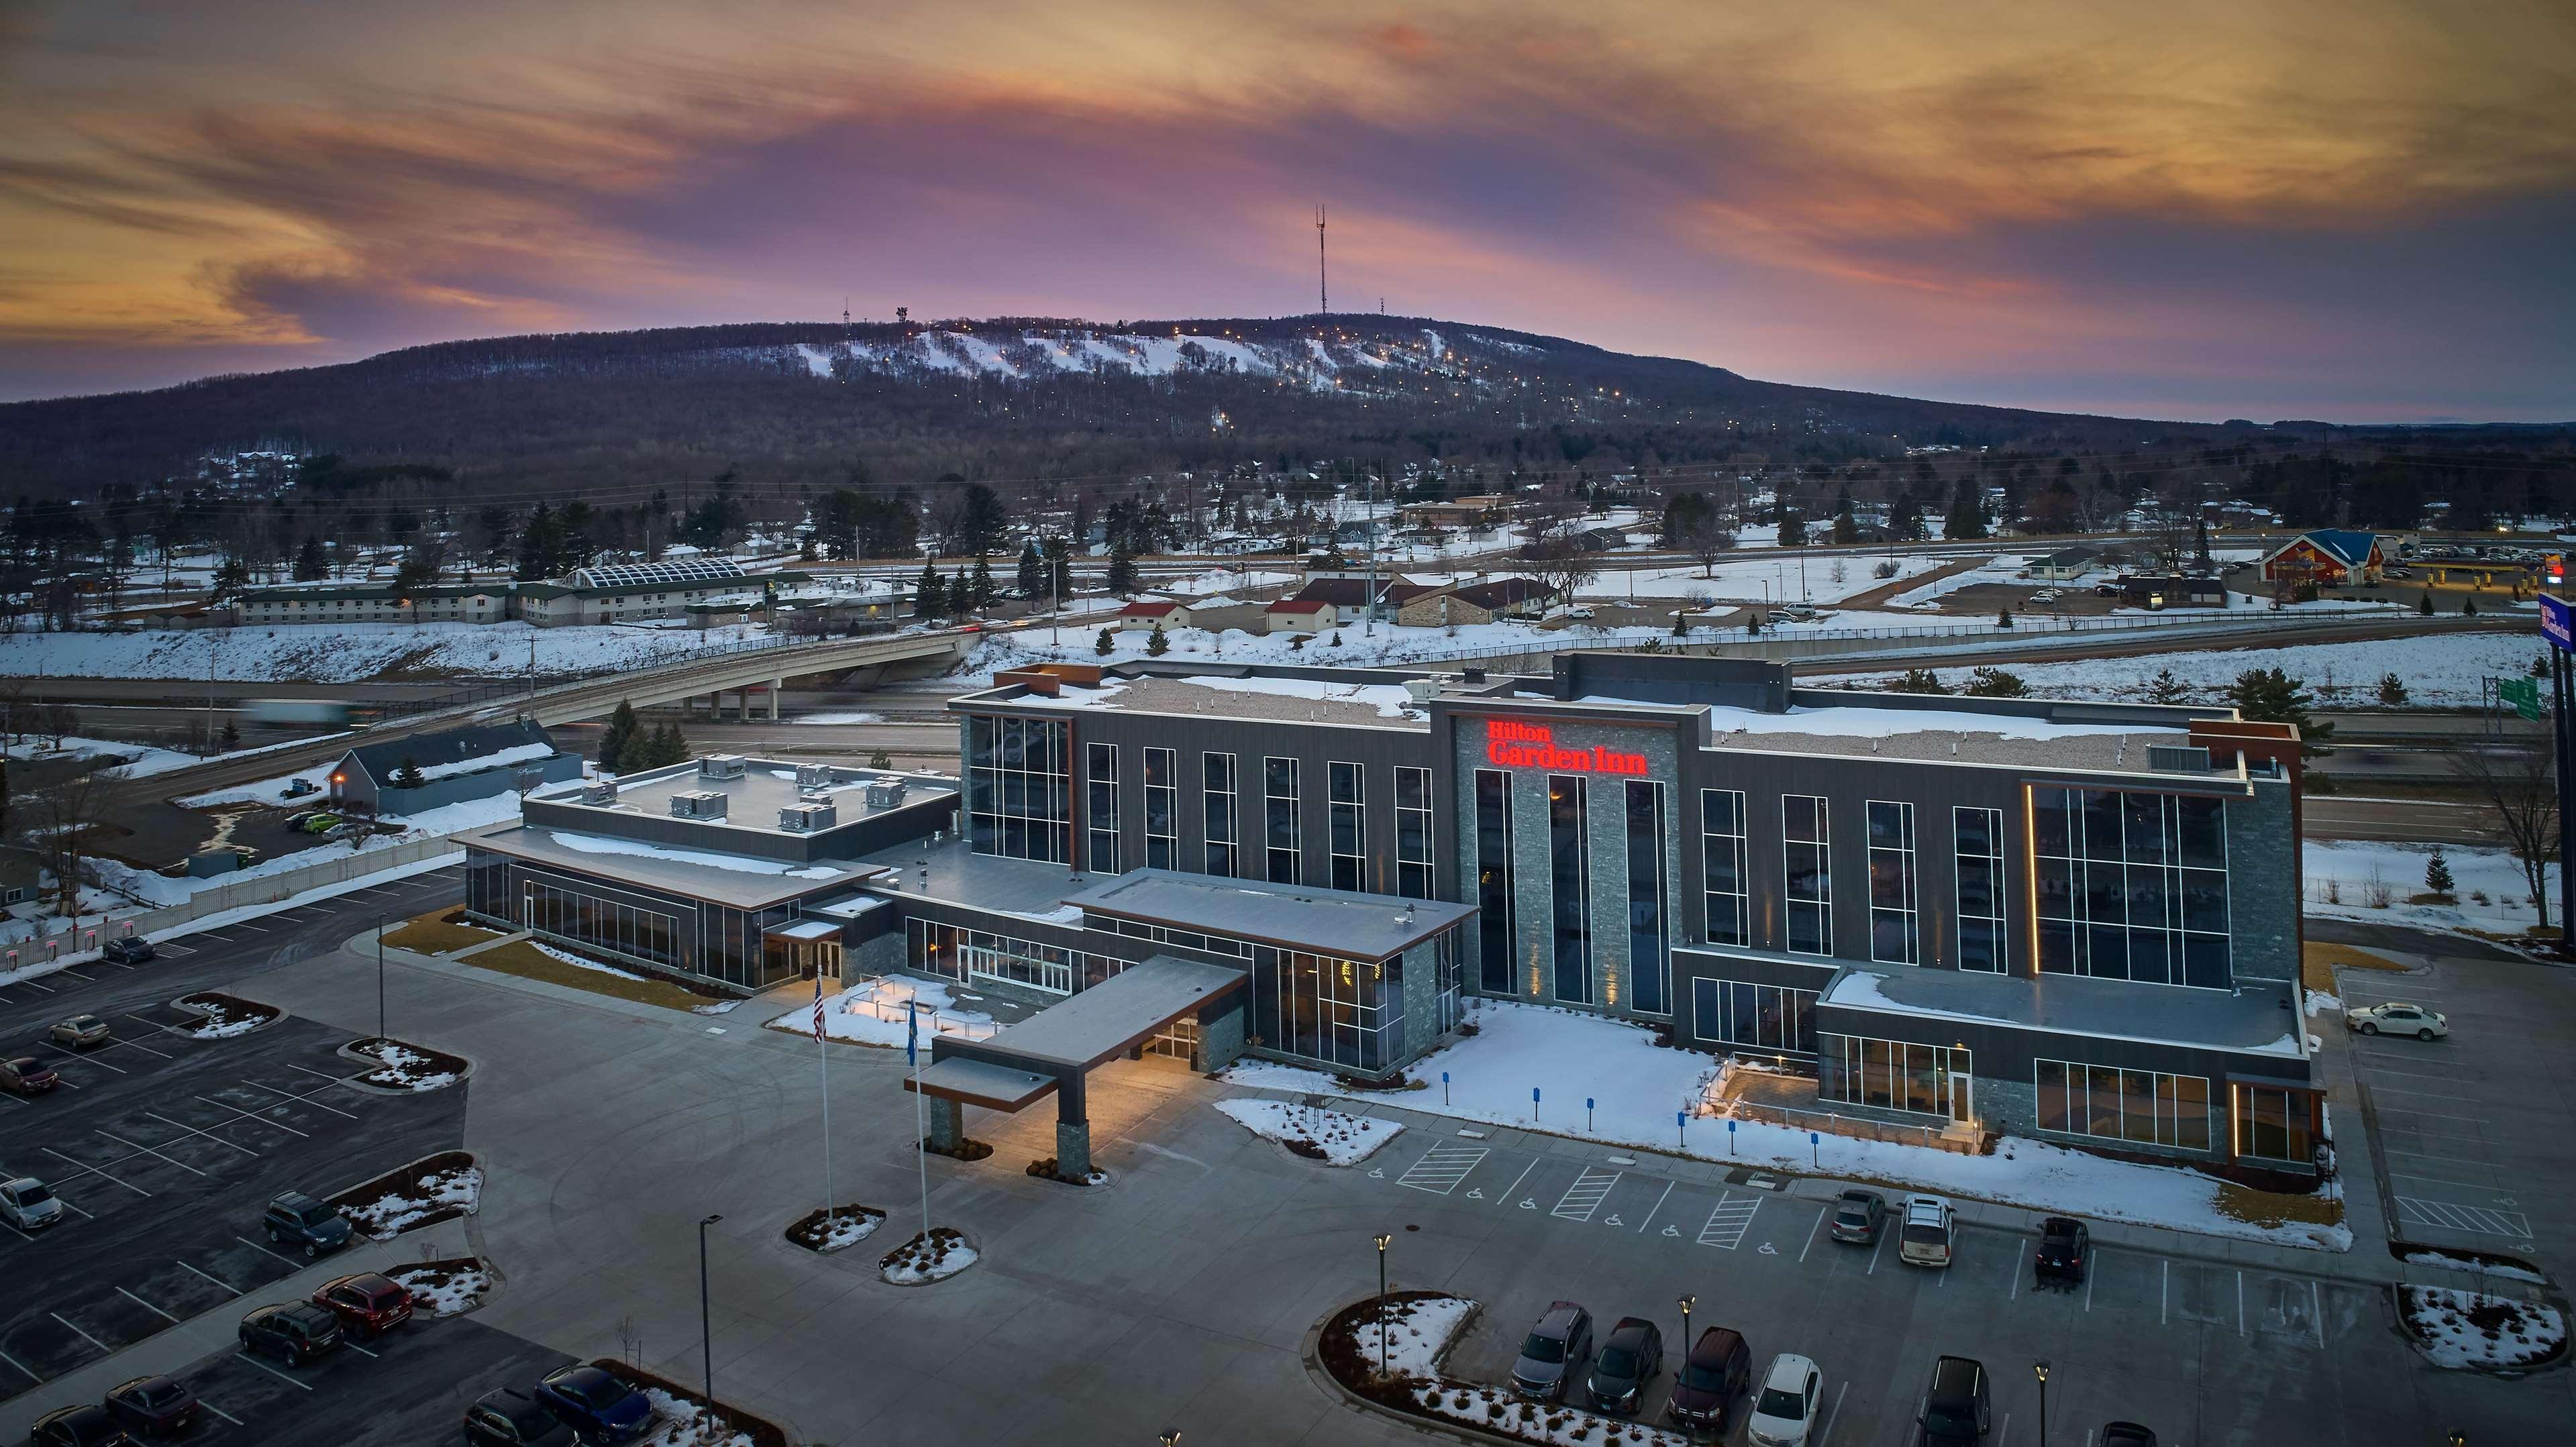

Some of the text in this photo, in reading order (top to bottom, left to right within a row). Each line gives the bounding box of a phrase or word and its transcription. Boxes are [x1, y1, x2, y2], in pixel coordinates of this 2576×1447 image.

[1488, 720, 1551, 742] Hilton
[1488, 740, 1647, 775] Garden Inn
